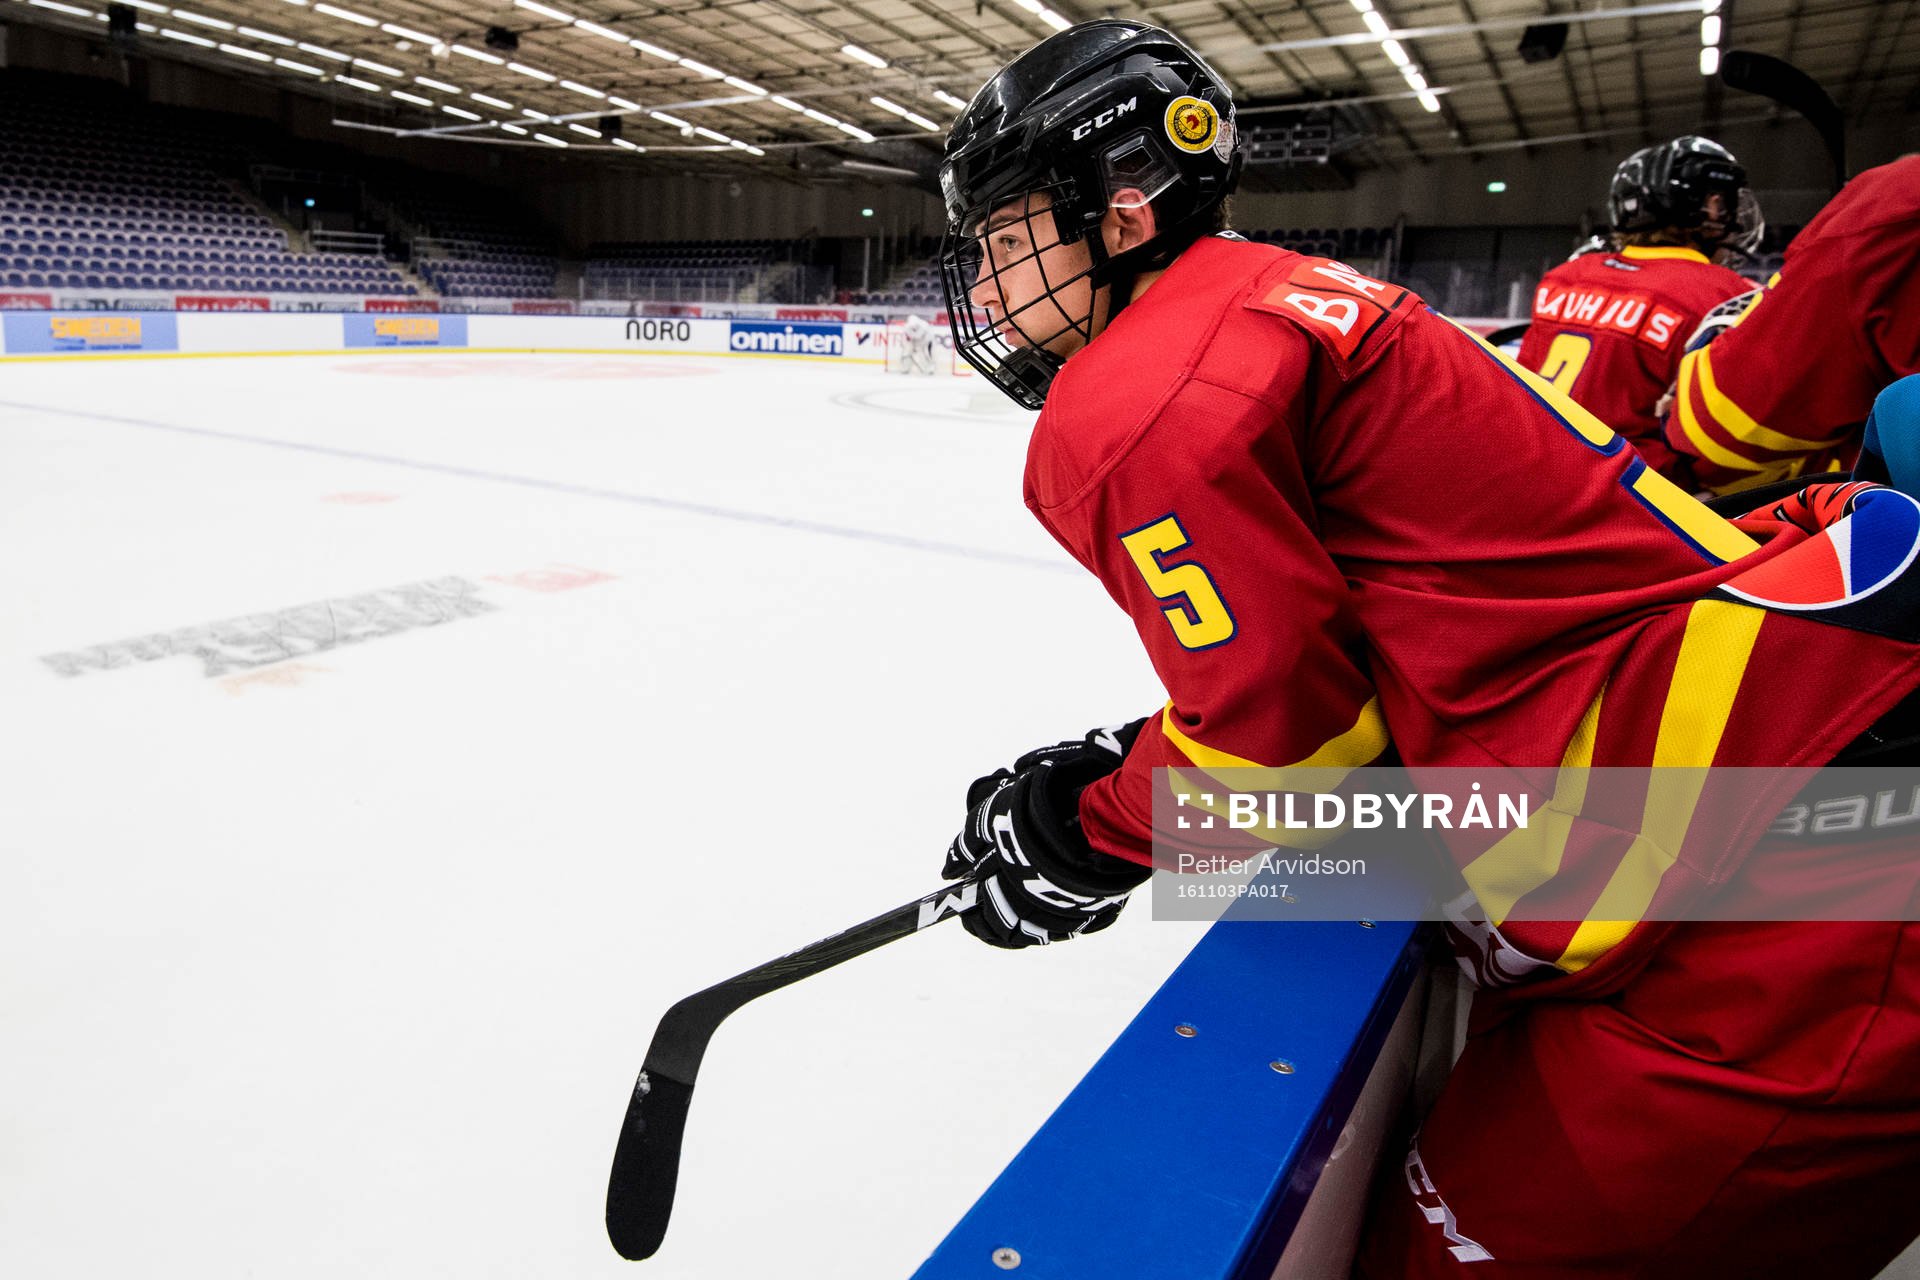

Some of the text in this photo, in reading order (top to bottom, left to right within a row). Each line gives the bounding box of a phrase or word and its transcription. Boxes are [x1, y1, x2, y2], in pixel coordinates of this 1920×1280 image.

[1072, 97, 1138, 141] CCM
[731, 325, 843, 354] onninen
[1117, 511, 1239, 652] 5
[1404, 1125, 1496, 1263] CM
